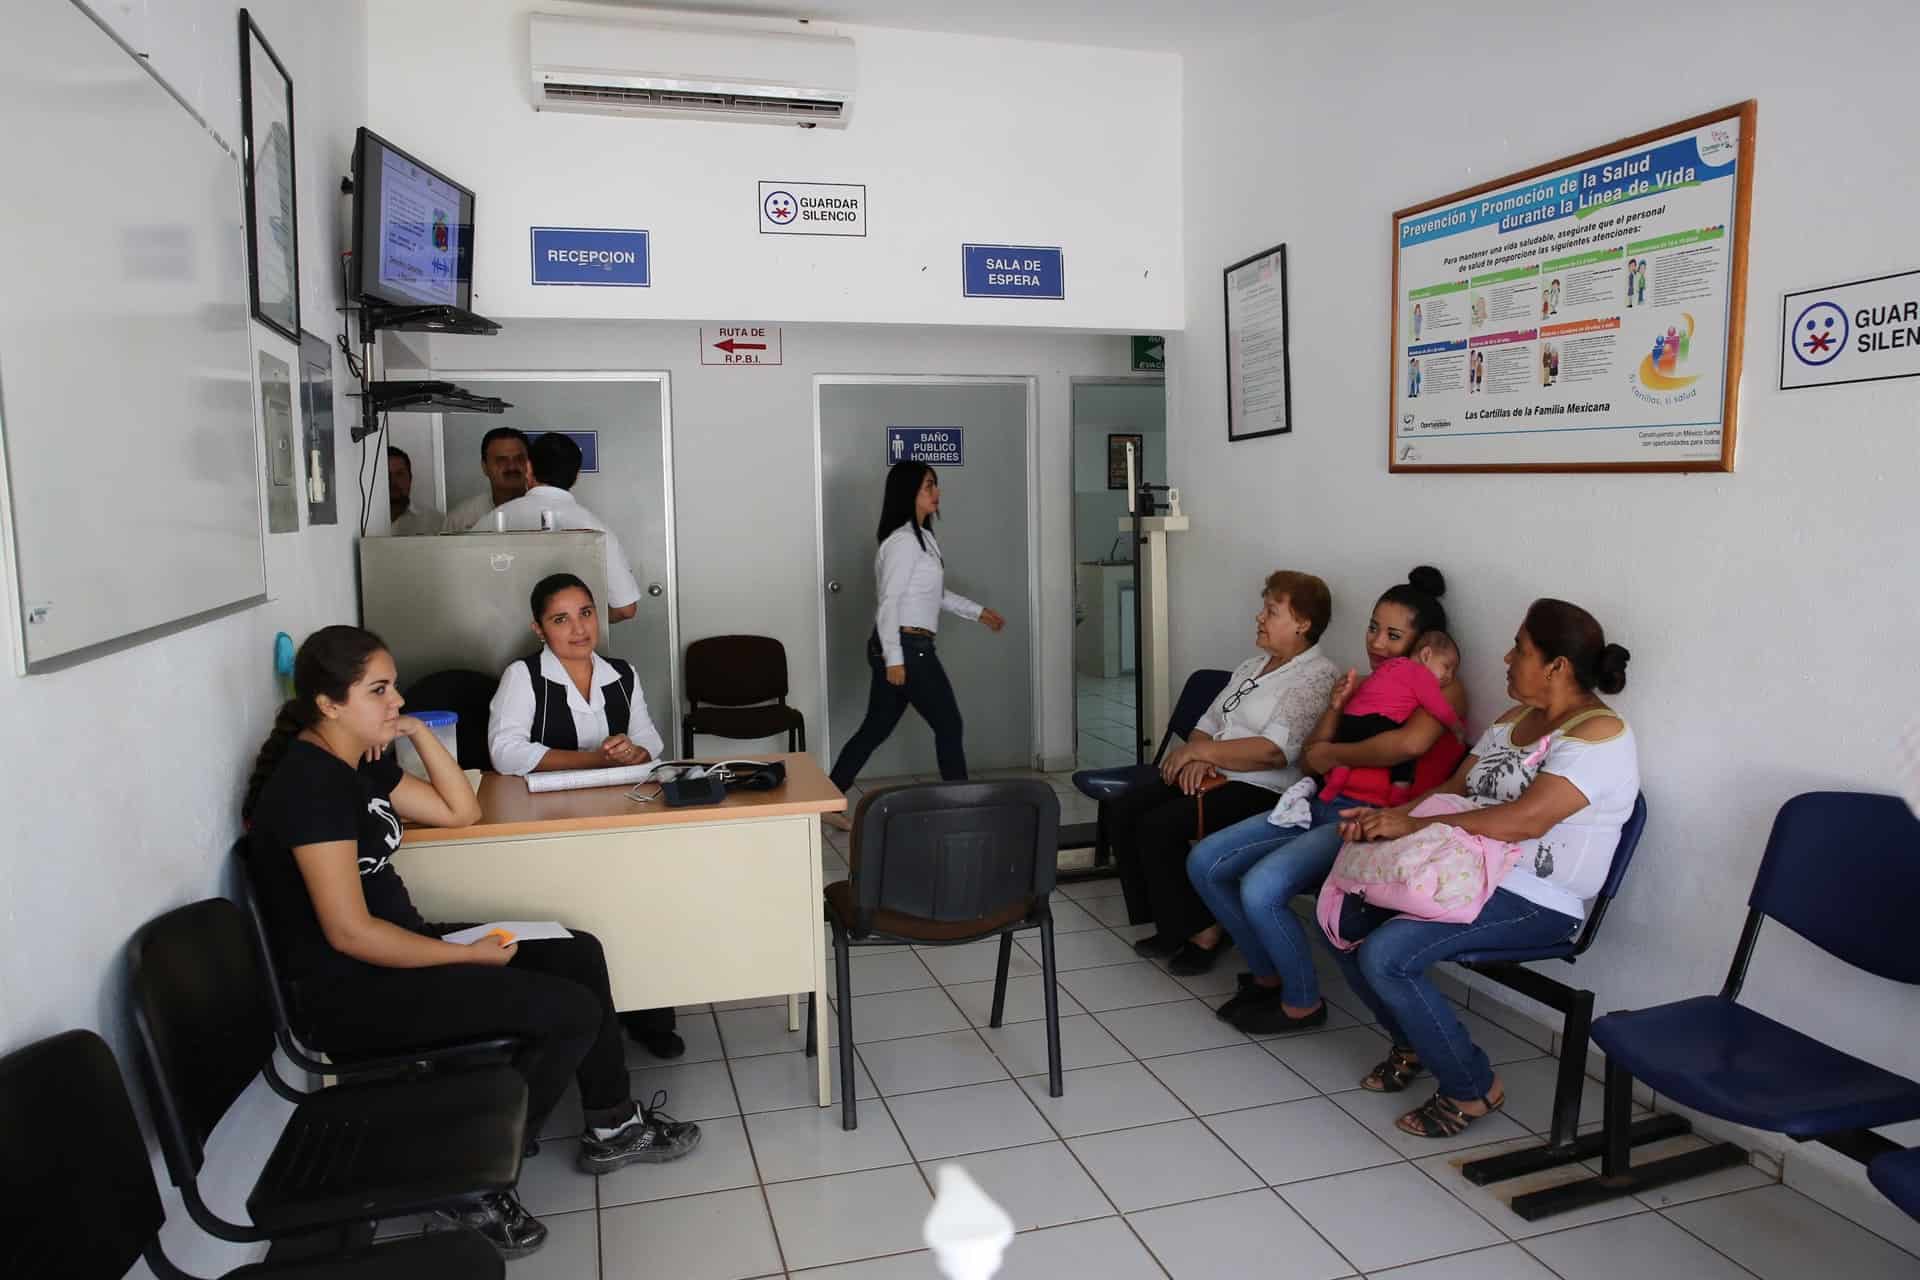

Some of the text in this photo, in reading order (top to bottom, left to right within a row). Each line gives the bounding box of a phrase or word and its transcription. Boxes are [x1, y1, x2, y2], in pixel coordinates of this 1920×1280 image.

[1402, 154, 1650, 238] Prevención y Promoción de la Salud
[1502, 167, 1695, 229] durante la Línea de Vida
[800, 197, 858, 209] GUARDAR
[802, 210, 857, 222] SILENCIO
[1443, 205, 1666, 265] Para mantener una vida saludable, asegúrate que el personal
[1459, 264, 1467, 272] de
[1468, 261, 1485, 270] salud
[1494, 251, 1537, 266] proporcione
[1538, 246, 1549, 254] las
[1551, 235, 1590, 253] siguientes
[1592, 225, 1641, 242] atenciones:
[547, 249, 635, 264] RECEPCION
[986, 258, 1041, 271] SALA DE
[988, 273, 1041, 286] ESPERA
[719, 327, 765, 337] RUTA DE
[725, 354, 761, 363] R.P.B.I.
[1465, 402, 1611, 420] Las Cartillas de la Familia Mexicana
[920, 432, 949, 442] BAÑO
[913, 443, 956, 452] PUBLICO
[911, 452, 960, 461] HOMBRES
